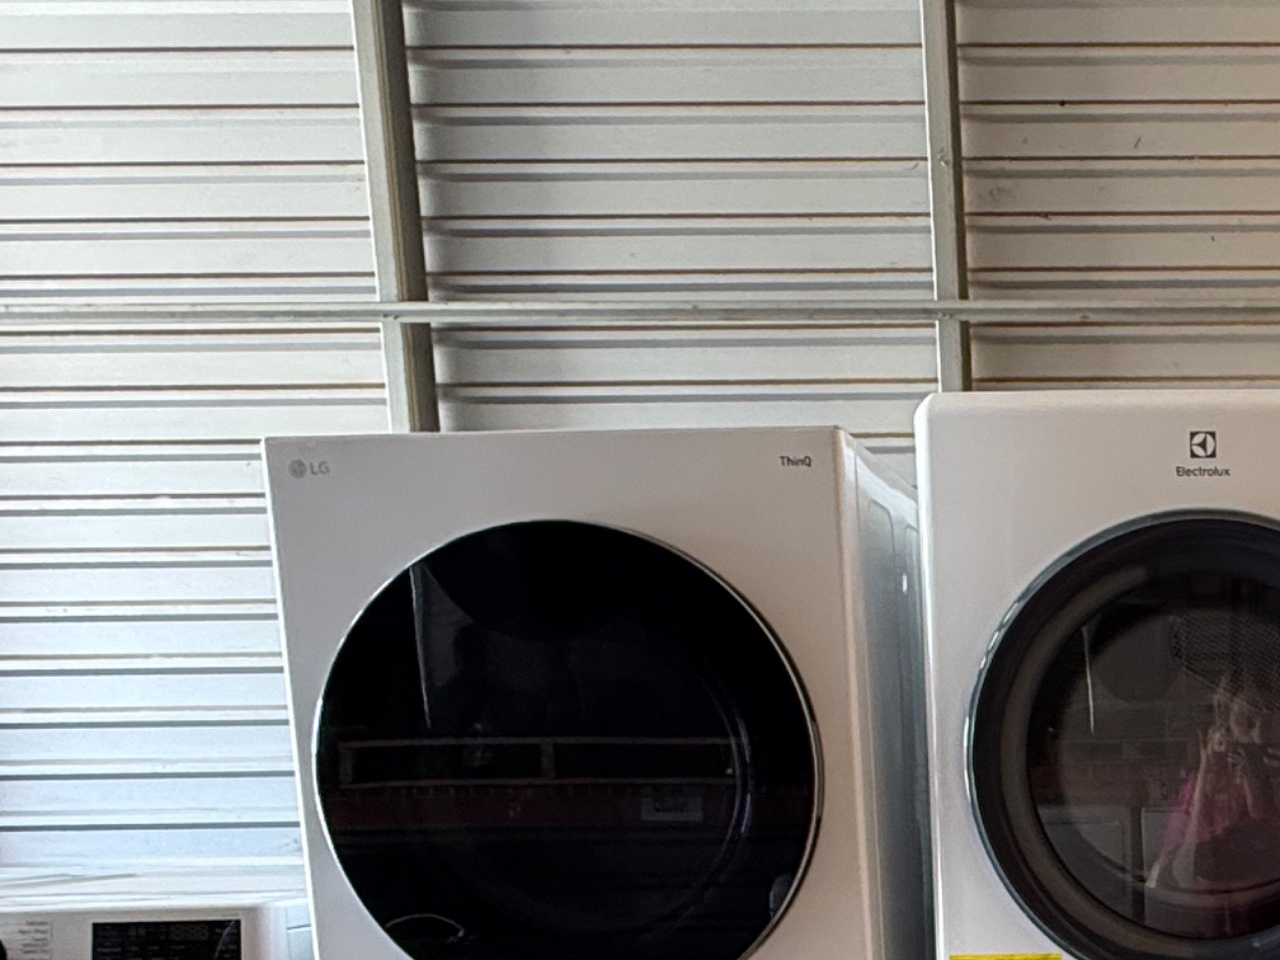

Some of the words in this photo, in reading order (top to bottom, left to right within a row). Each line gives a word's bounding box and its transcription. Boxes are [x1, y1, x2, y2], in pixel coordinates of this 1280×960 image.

[309, 460, 331, 476] LG
[779, 455, 812, 468] ThinQ
[1176, 465, 1231, 477] Electrolux
